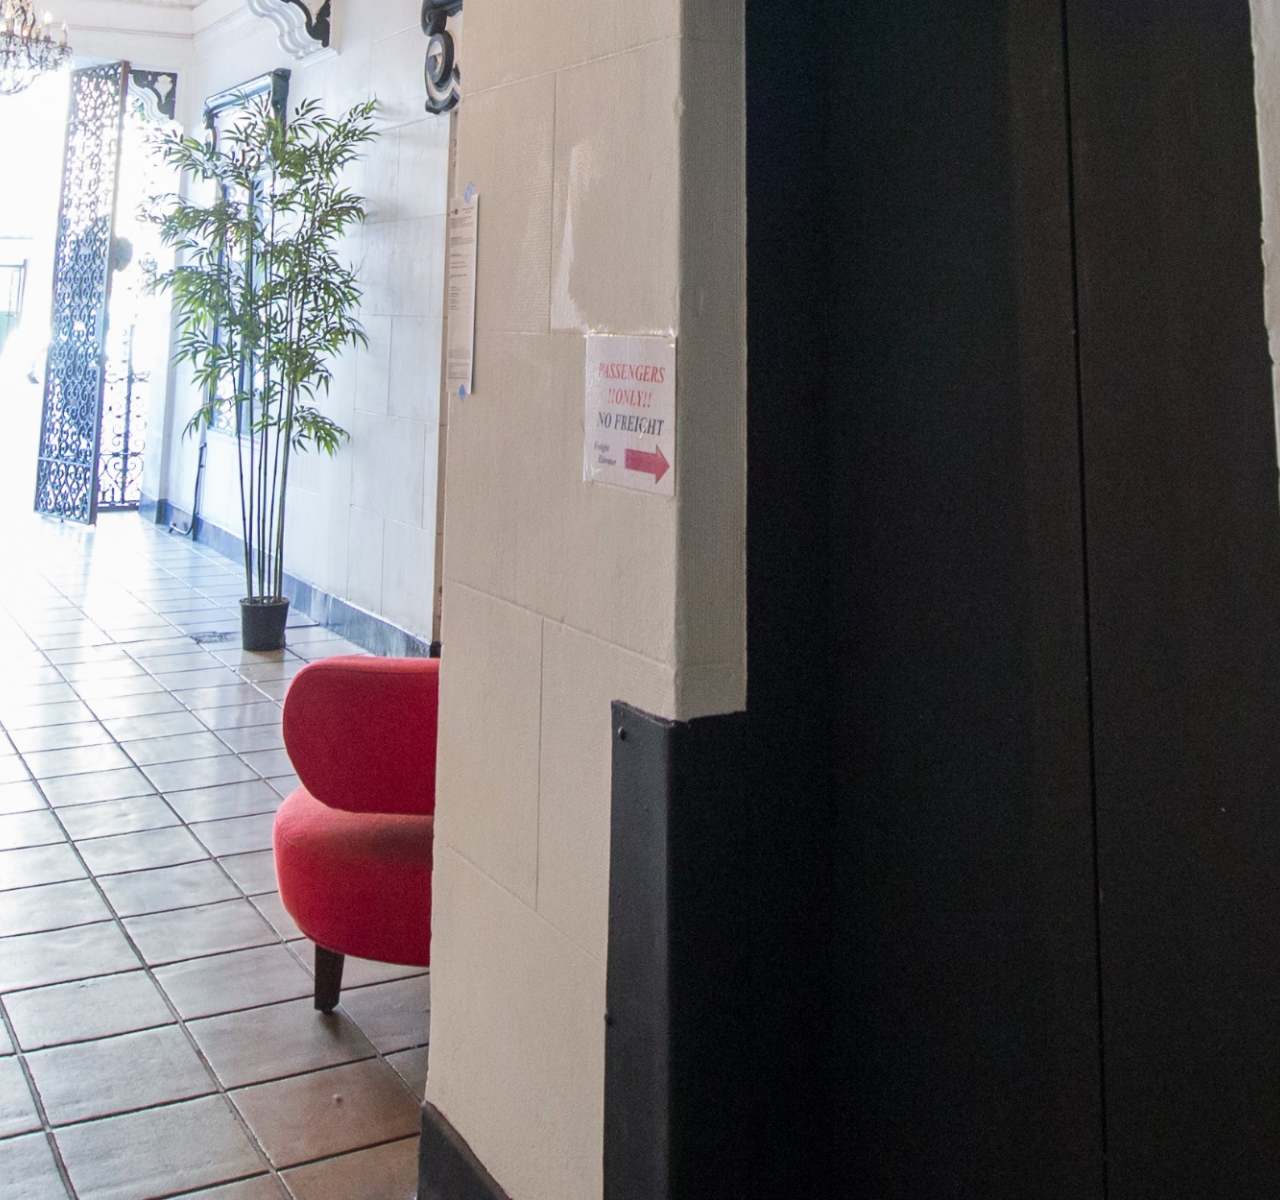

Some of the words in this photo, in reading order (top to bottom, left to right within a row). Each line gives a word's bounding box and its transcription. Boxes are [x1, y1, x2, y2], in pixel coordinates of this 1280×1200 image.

[598, 362, 666, 384] PASSENGERS
[597, 412, 612, 429] NO
[614, 413, 665, 437] FREIGHT
